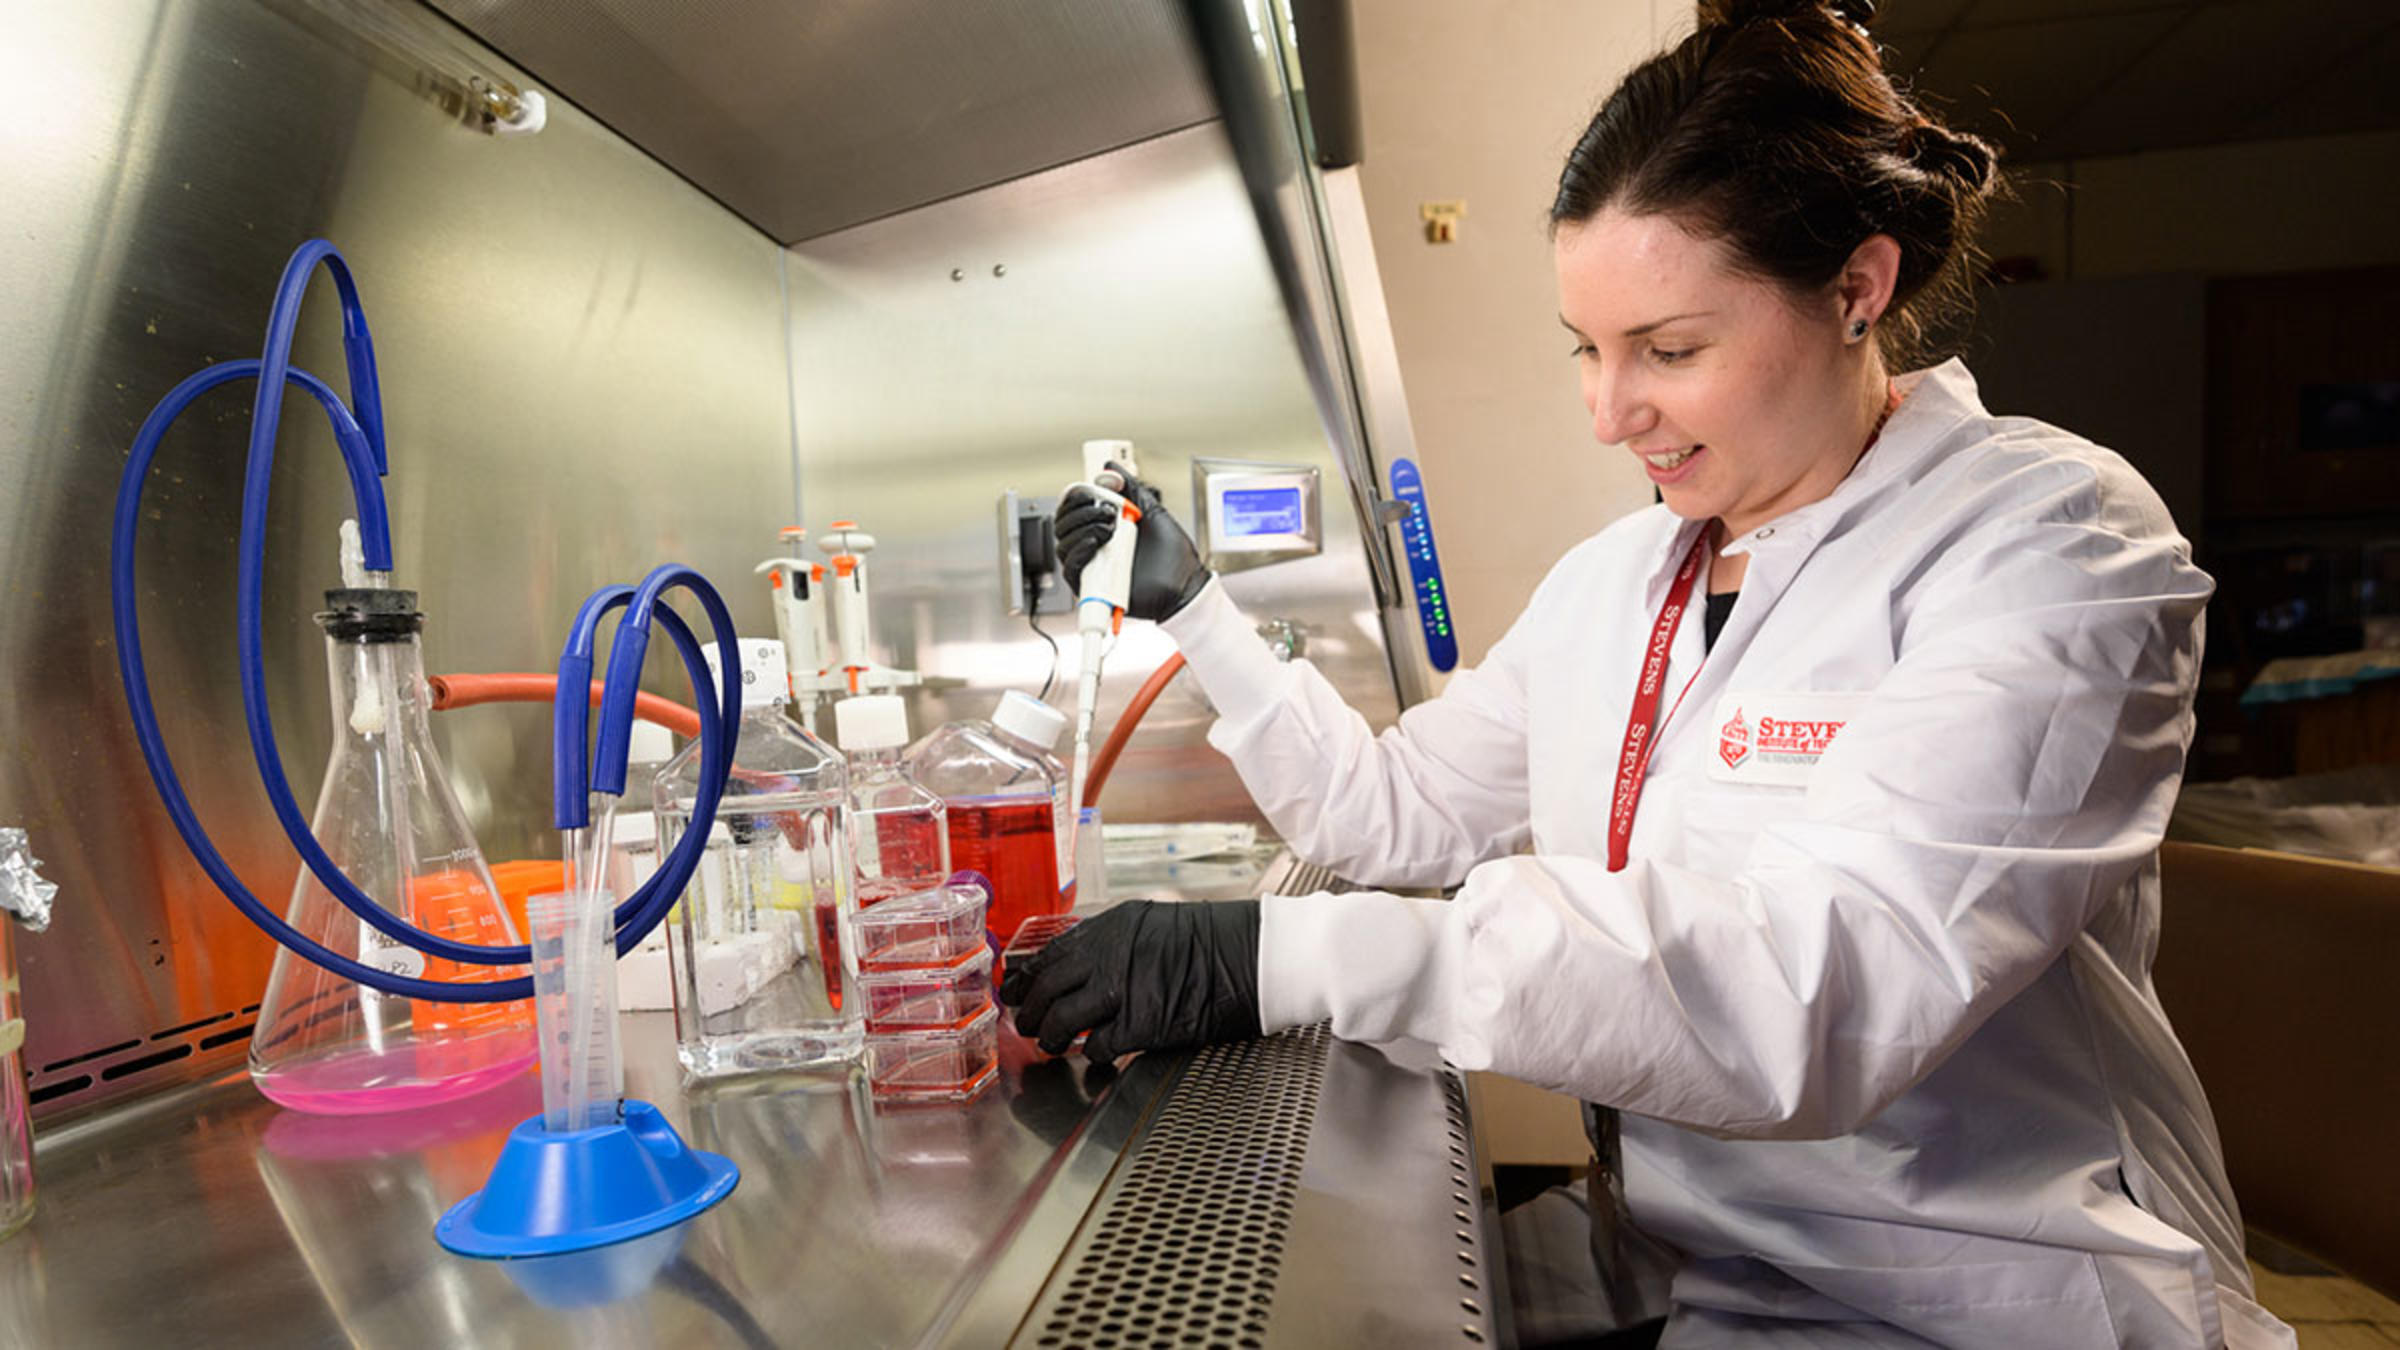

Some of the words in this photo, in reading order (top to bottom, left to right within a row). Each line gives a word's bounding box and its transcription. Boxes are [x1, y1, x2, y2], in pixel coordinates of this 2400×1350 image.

[1642, 605, 1681, 695] STEVENS
[1615, 723, 1647, 818] STEVENS
[1758, 717, 1847, 738] STEVE
